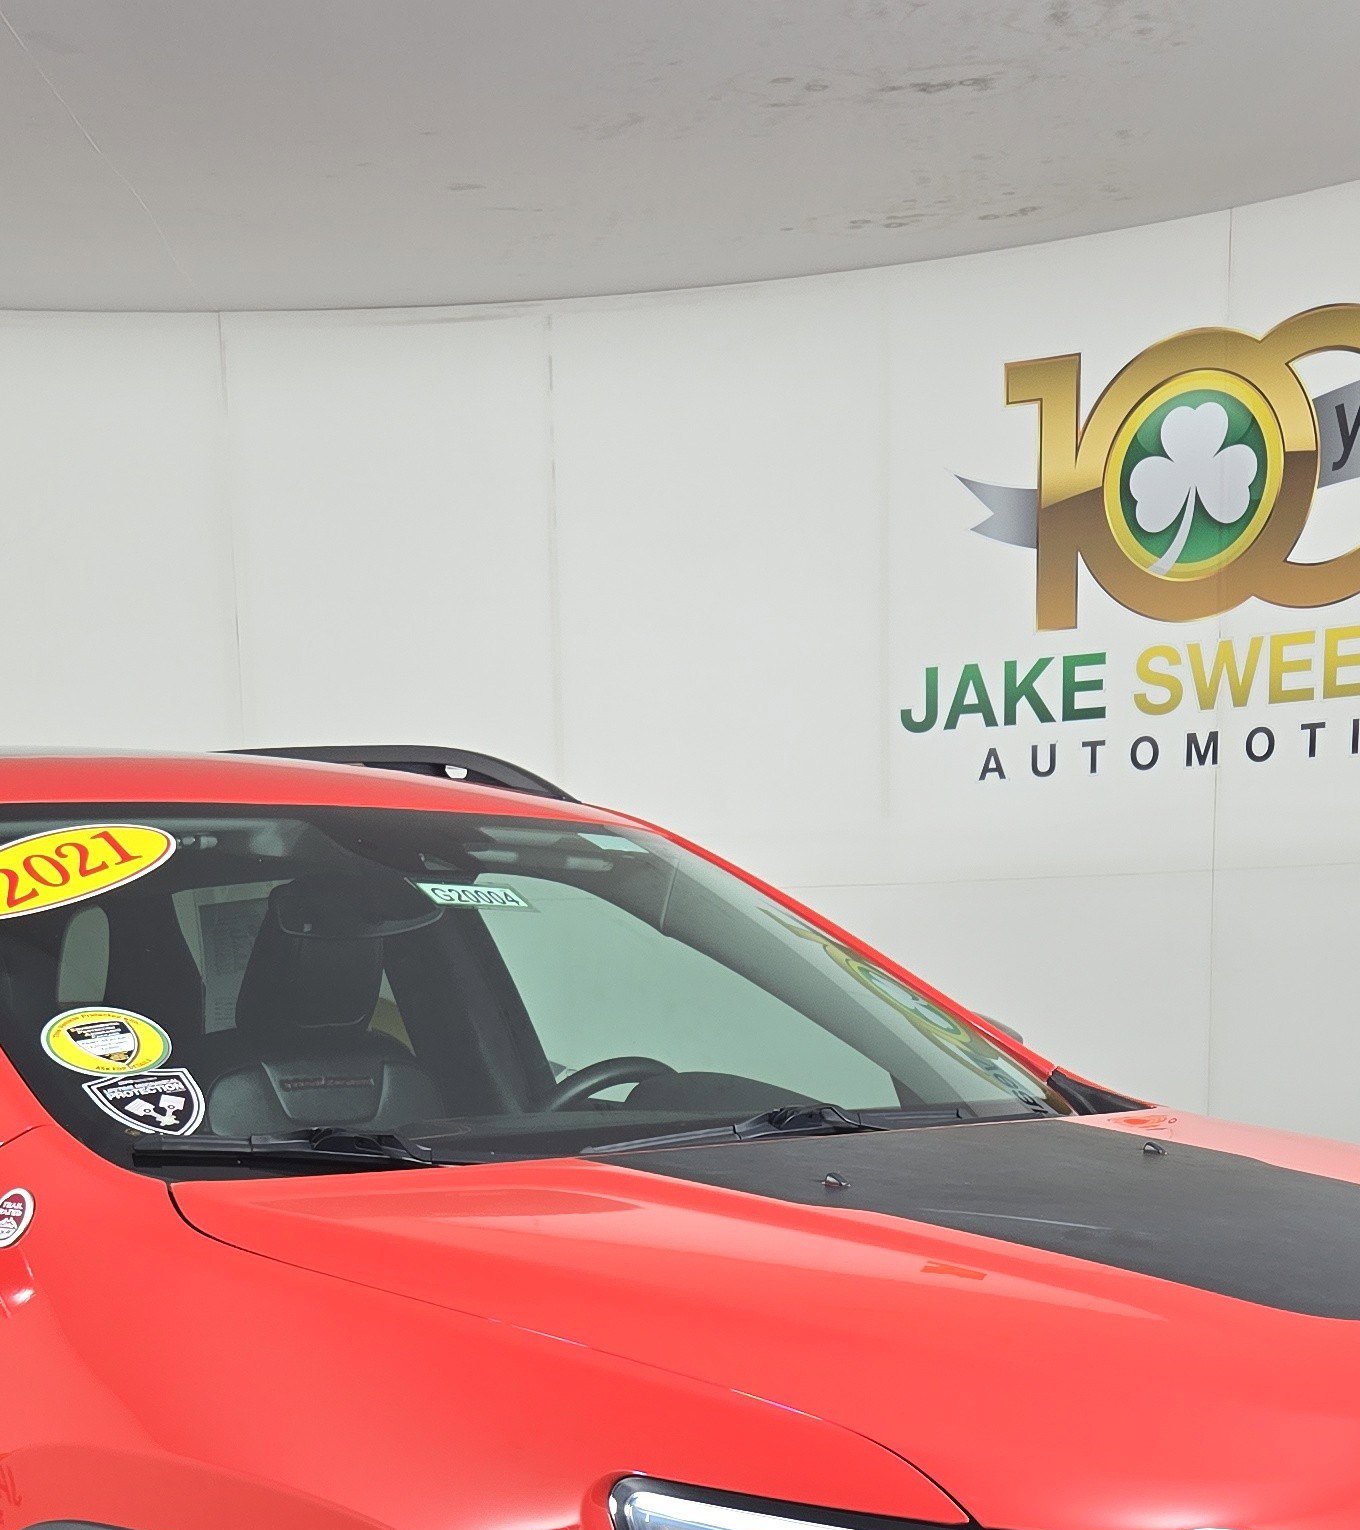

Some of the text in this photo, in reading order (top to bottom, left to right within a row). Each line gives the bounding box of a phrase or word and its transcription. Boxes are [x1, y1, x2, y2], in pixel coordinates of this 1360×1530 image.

[900, 651, 1107, 734] JAKE
[431, 887, 520, 906] G20004
[106, 1082, 186, 1101] PROTECTION
